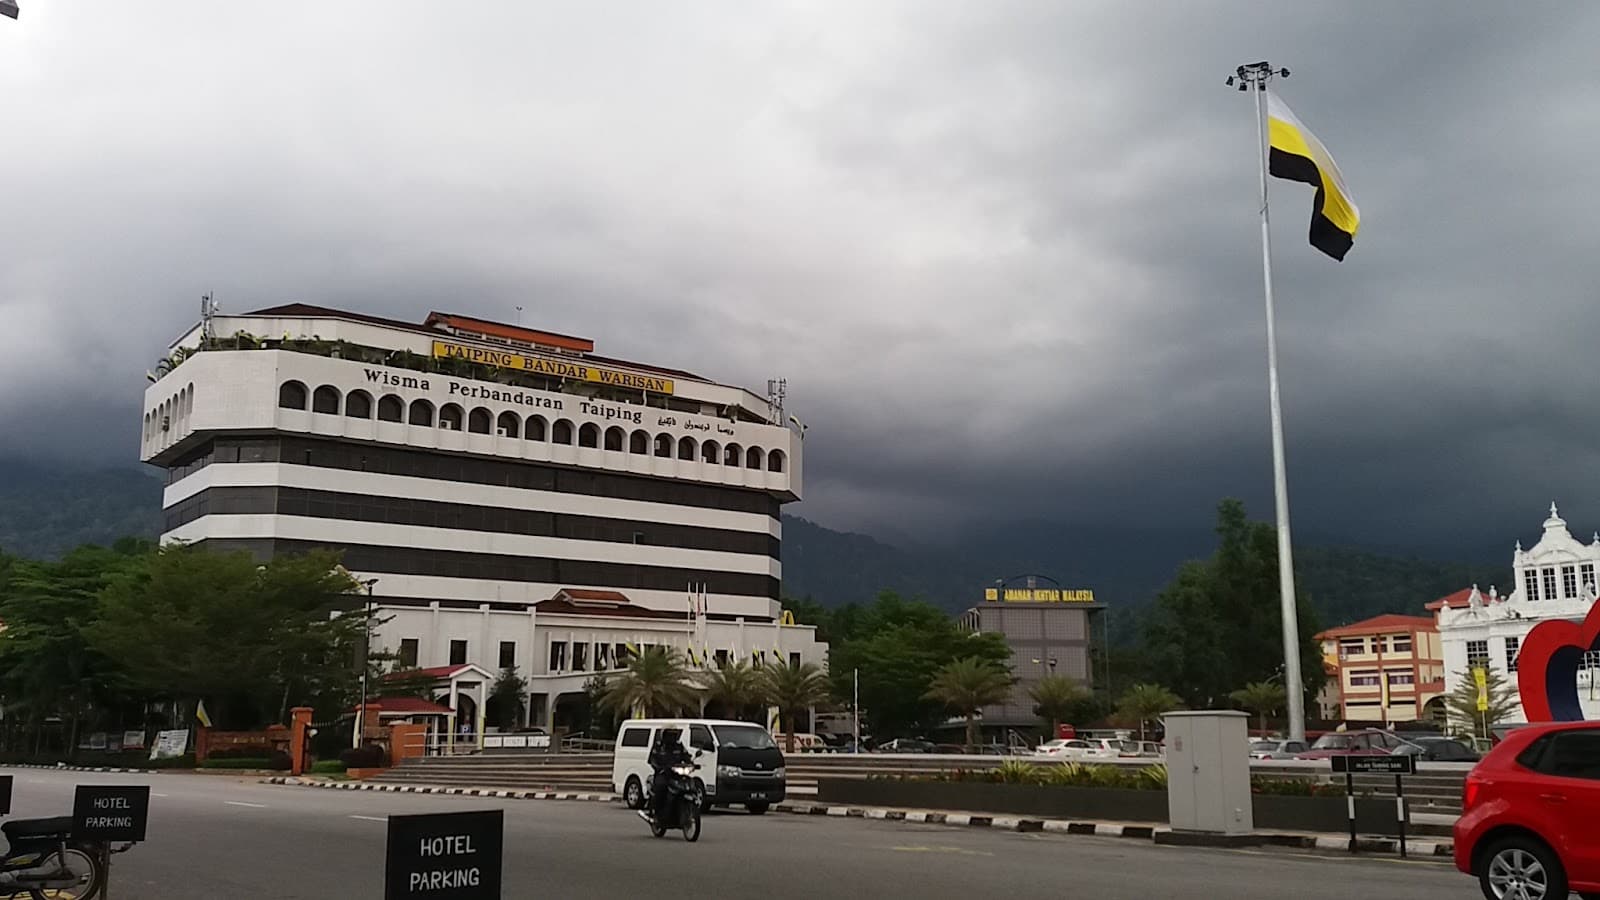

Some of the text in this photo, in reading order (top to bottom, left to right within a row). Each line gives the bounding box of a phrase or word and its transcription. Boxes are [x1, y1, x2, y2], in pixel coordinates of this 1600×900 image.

[444, 345, 665, 391] TAIPING BANDAR WARISAN
[364, 369, 642, 424] Wisma Perbandaran Taiping
[94, 797, 130, 809] HOTEL
[85, 816, 132, 828] PARKING
[420, 835, 477, 857] HOTEL
[409, 867, 480, 892] PARKING
